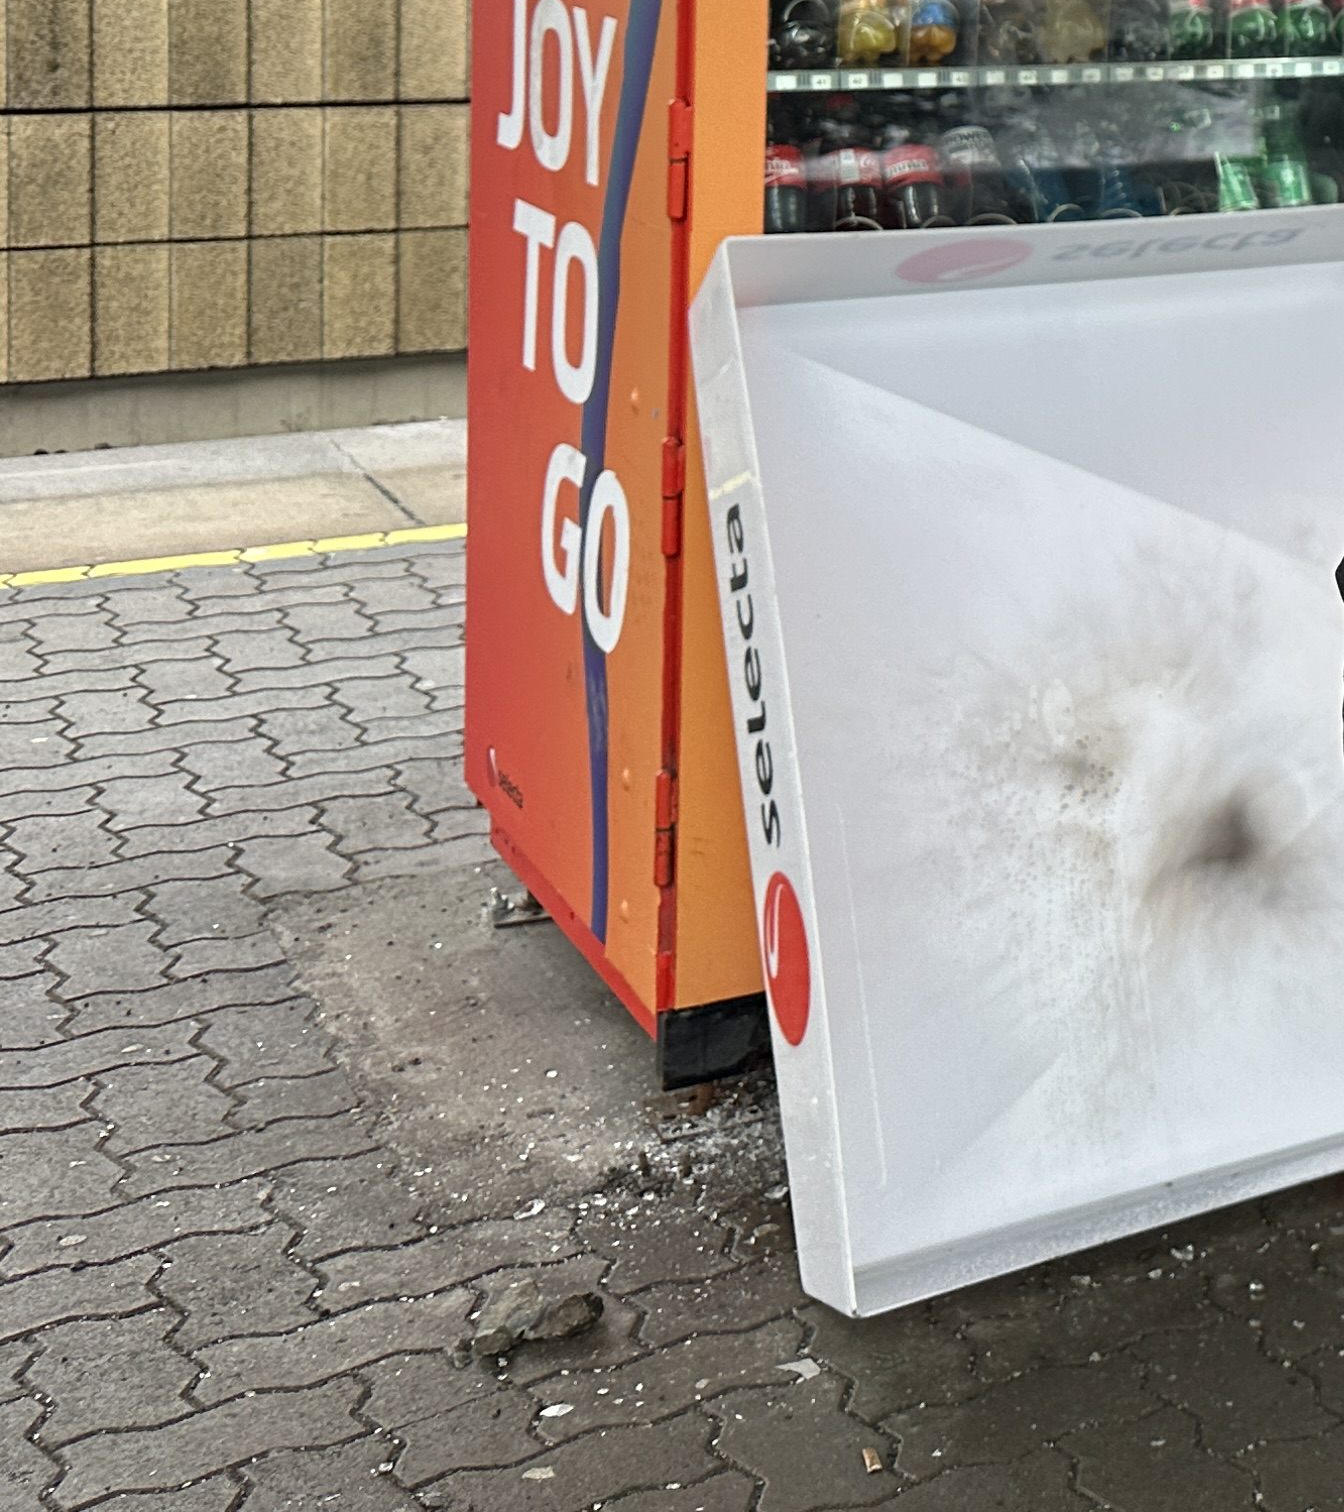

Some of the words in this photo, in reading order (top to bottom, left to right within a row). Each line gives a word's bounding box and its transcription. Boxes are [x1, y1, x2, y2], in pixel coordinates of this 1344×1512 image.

[512, 198, 600, 405] TO
[540, 441, 631, 654] GO
[725, 502, 782, 849] selecta
